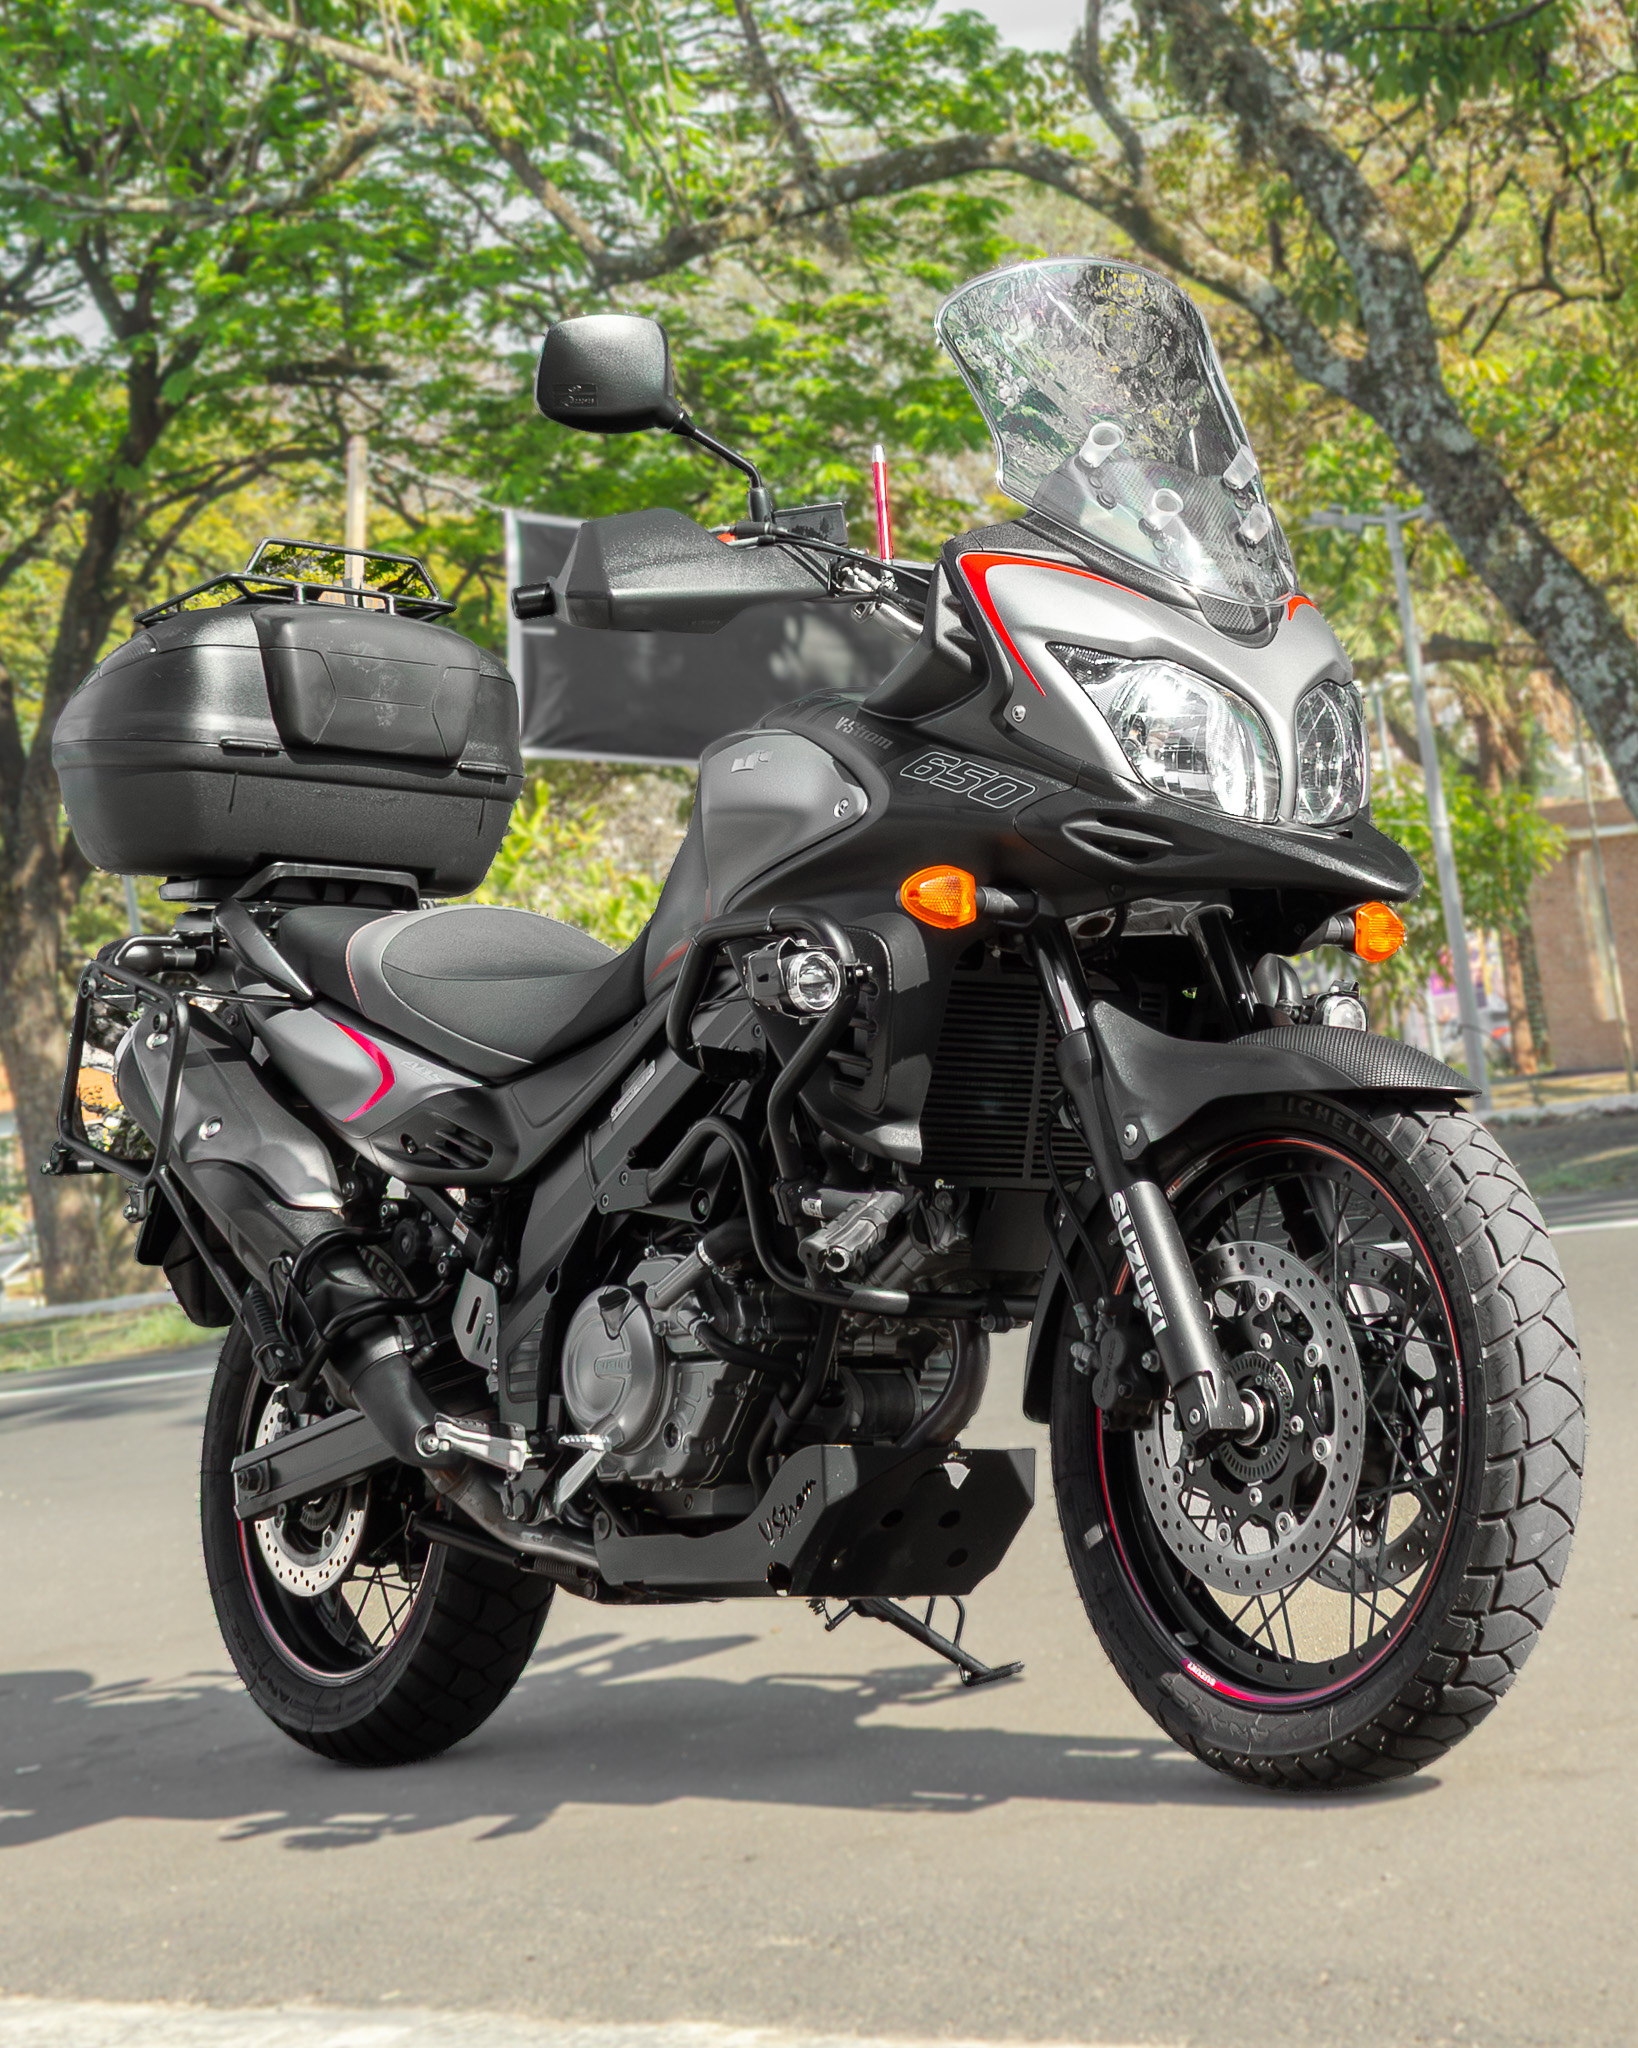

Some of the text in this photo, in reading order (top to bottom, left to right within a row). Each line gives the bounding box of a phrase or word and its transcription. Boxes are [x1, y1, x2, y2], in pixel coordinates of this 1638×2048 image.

[899, 751, 1036, 809] 650
[1265, 1095, 1391, 1164] ICHELIN
[1109, 1191, 1168, 1336] SUZUKI
[1186, 1661, 1217, 1687] SUZUKI
